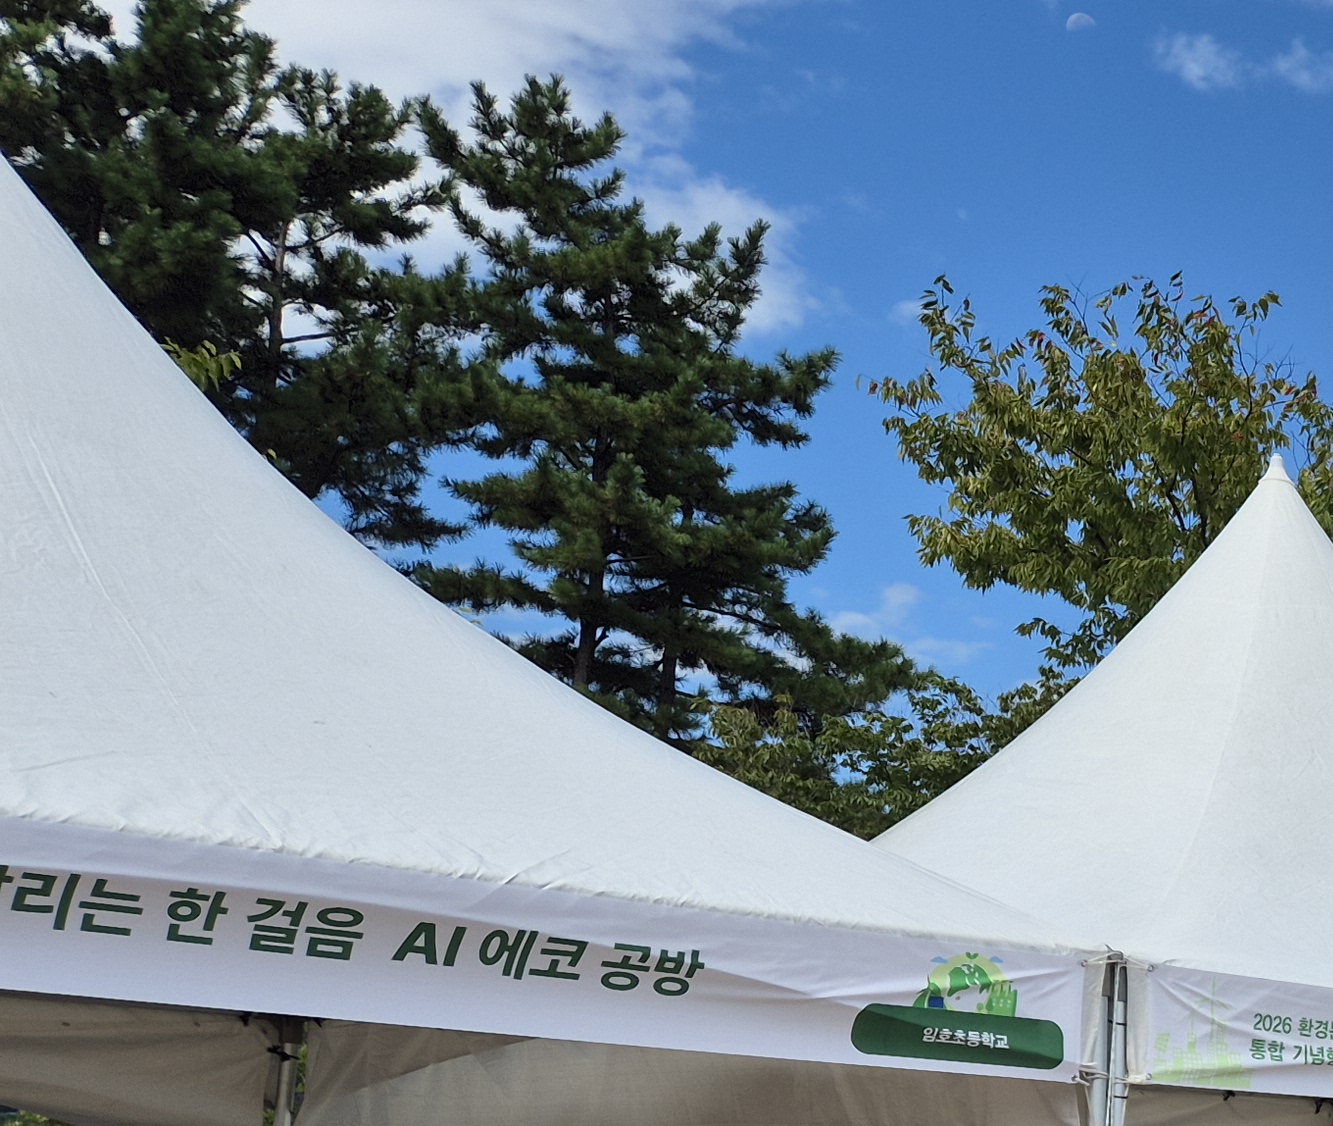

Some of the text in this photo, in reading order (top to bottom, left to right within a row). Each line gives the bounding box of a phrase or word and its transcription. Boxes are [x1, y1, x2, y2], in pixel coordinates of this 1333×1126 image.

[166, 887, 229, 946] 한
[246, 897, 365, 961] 걸음
[391, 922, 467, 967] AI
[478, 929, 590, 981] 에코
[600, 942, 705, 997] 공방
[1253, 1012, 1292, 1035] 2026
[922, 1026, 1010, 1050] 임호초등학교
[1249, 1038, 1286, 1062] 통합
